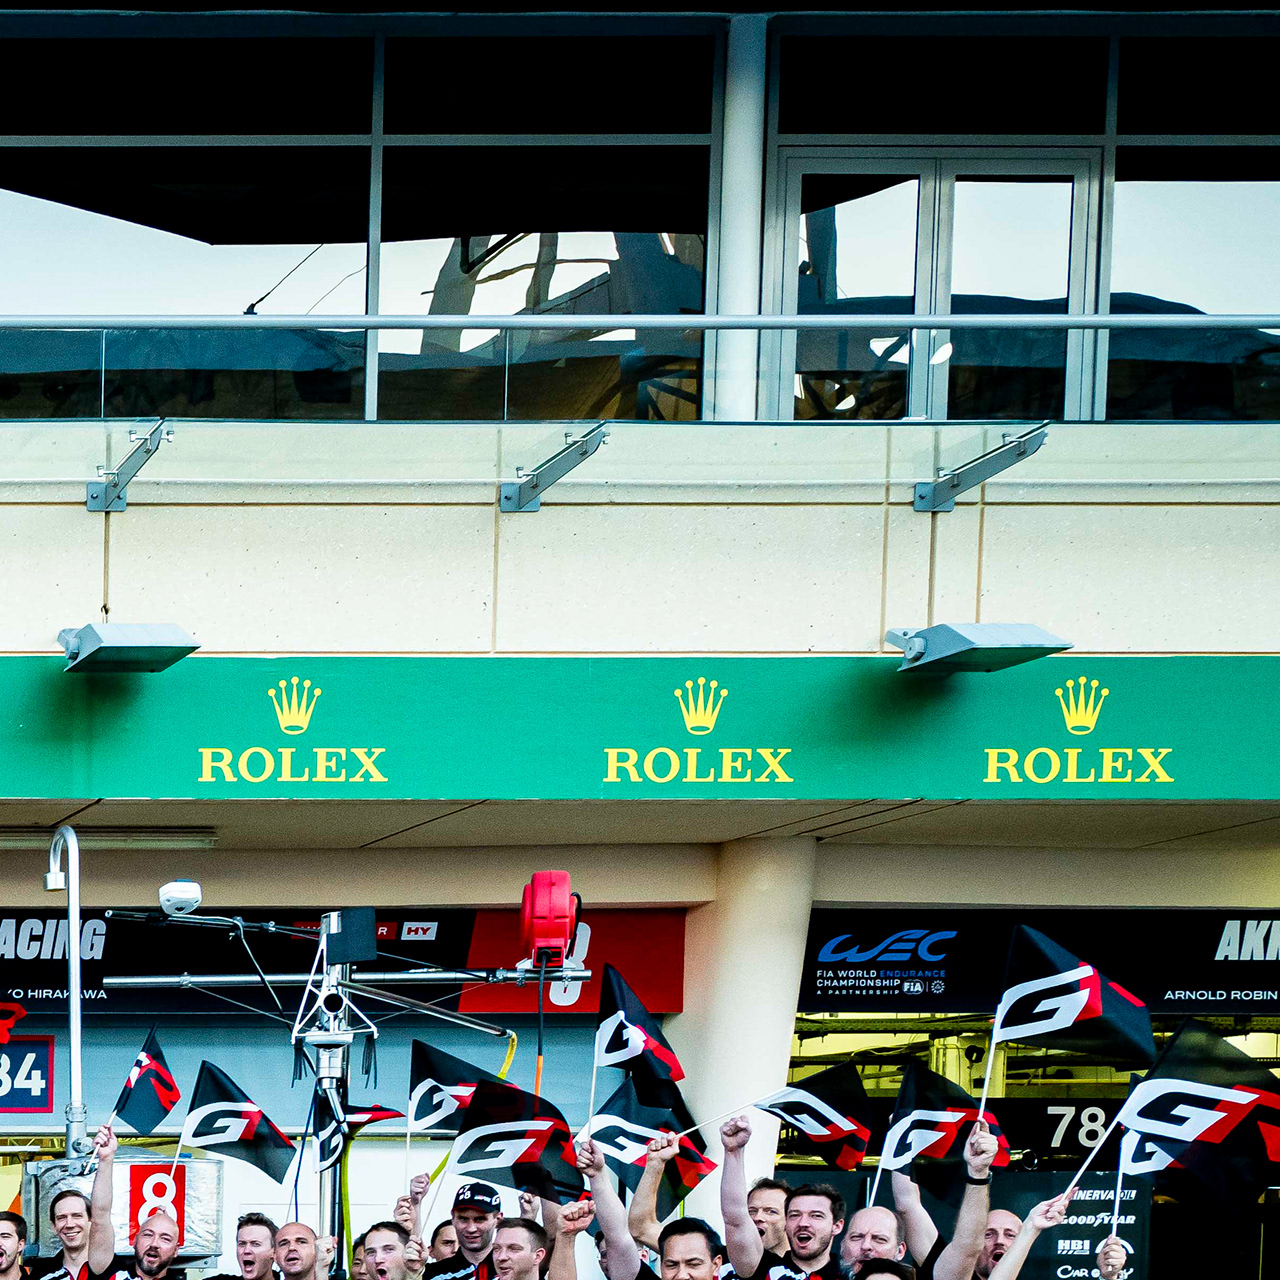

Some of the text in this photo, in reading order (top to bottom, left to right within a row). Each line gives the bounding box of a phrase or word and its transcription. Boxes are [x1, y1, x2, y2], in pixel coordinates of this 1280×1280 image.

[200, 748, 385, 783] ROLEX
[605, 748, 792, 783] ROLEX
[986, 748, 1172, 783] ROLEX
[406, 925, 432, 938] HY
[817, 929, 957, 962] WEC
[817, 970, 946, 978] FIA WORLD ENDURANCE
[817, 979, 901, 987] CHAMPIONSHIP
[903, 981, 924, 993] FIA
[1165, 990, 1278, 1000] ARNOLD ROBIN
[1047, 1107, 1106, 1148] 78
[1058, 1240, 1090, 1250] HBI
